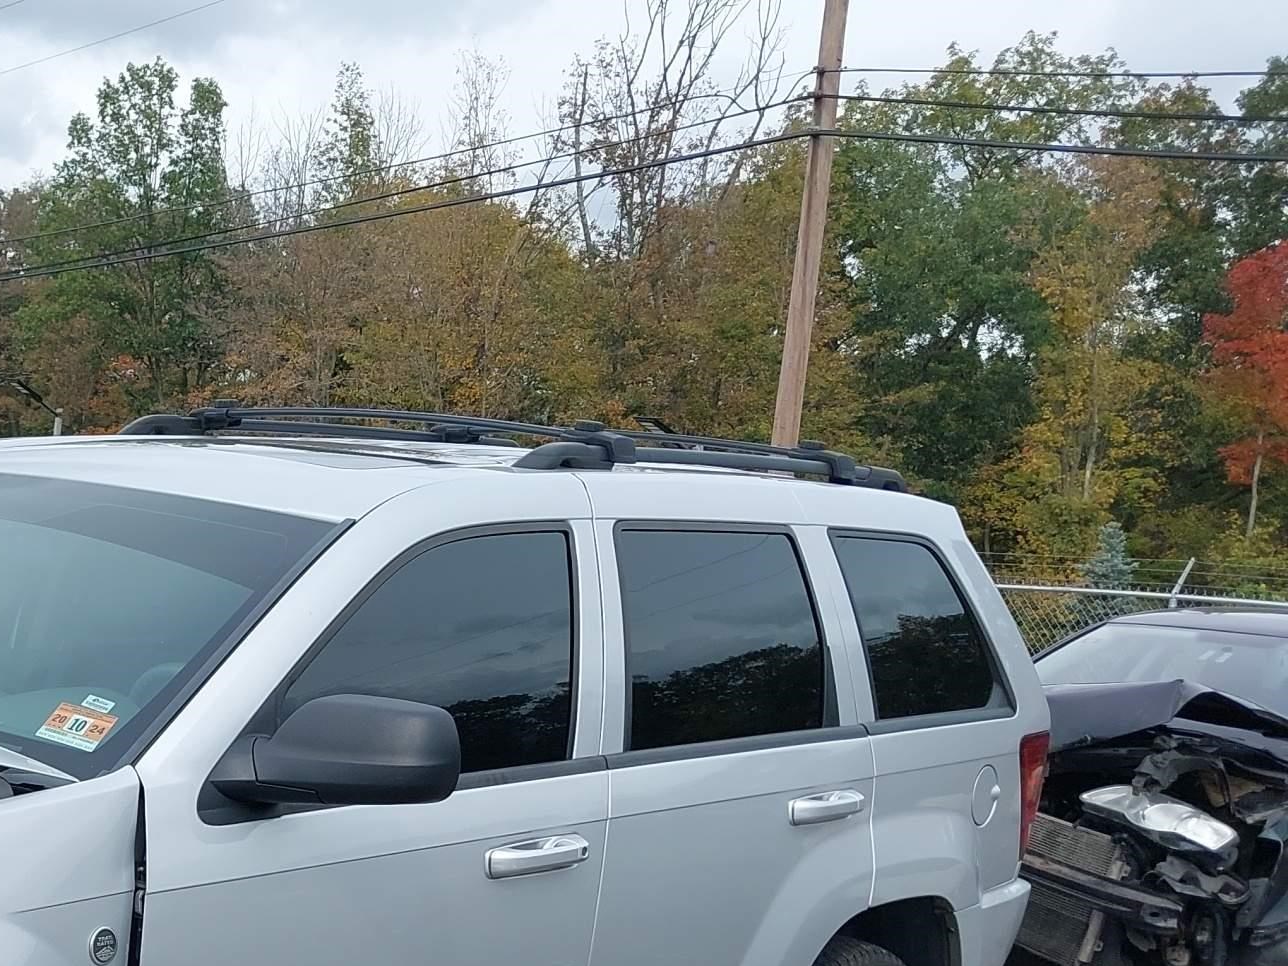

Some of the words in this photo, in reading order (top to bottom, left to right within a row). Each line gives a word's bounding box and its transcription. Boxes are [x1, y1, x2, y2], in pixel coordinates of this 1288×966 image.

[52, 713, 68, 724] 20
[67, 718, 88, 733] 10
[89, 725, 106, 735] 24
